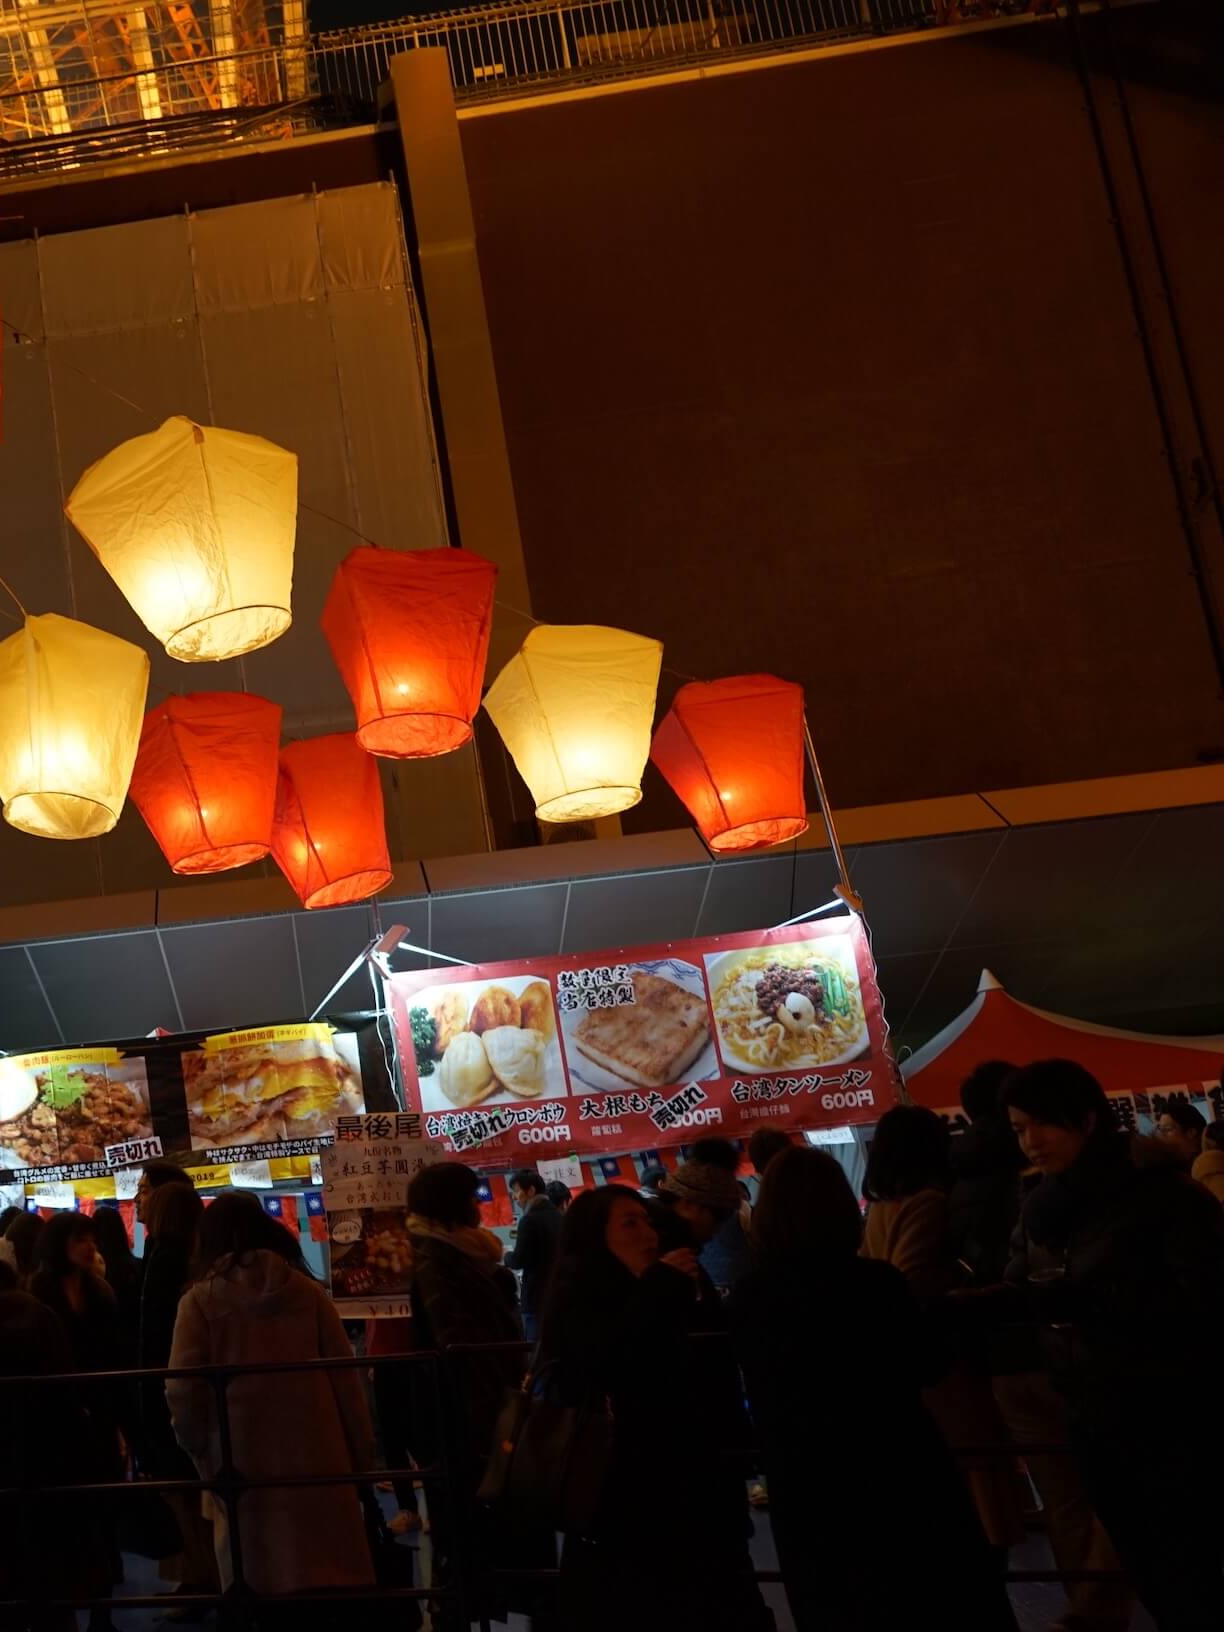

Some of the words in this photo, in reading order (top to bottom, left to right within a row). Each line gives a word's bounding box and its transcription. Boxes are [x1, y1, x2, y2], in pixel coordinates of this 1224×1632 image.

[732, 1069, 872, 1102] 台湾タンツーメン
[651, 1086, 705, 1129] 売切れ
[821, 1090, 875, 1110] 600円
[335, 1114, 423, 1141] 最後尾
[451, 1115, 507, 1149] 売切れ
[519, 1125, 572, 1145] 600円
[108, 1140, 161, 1165] 売切れ
